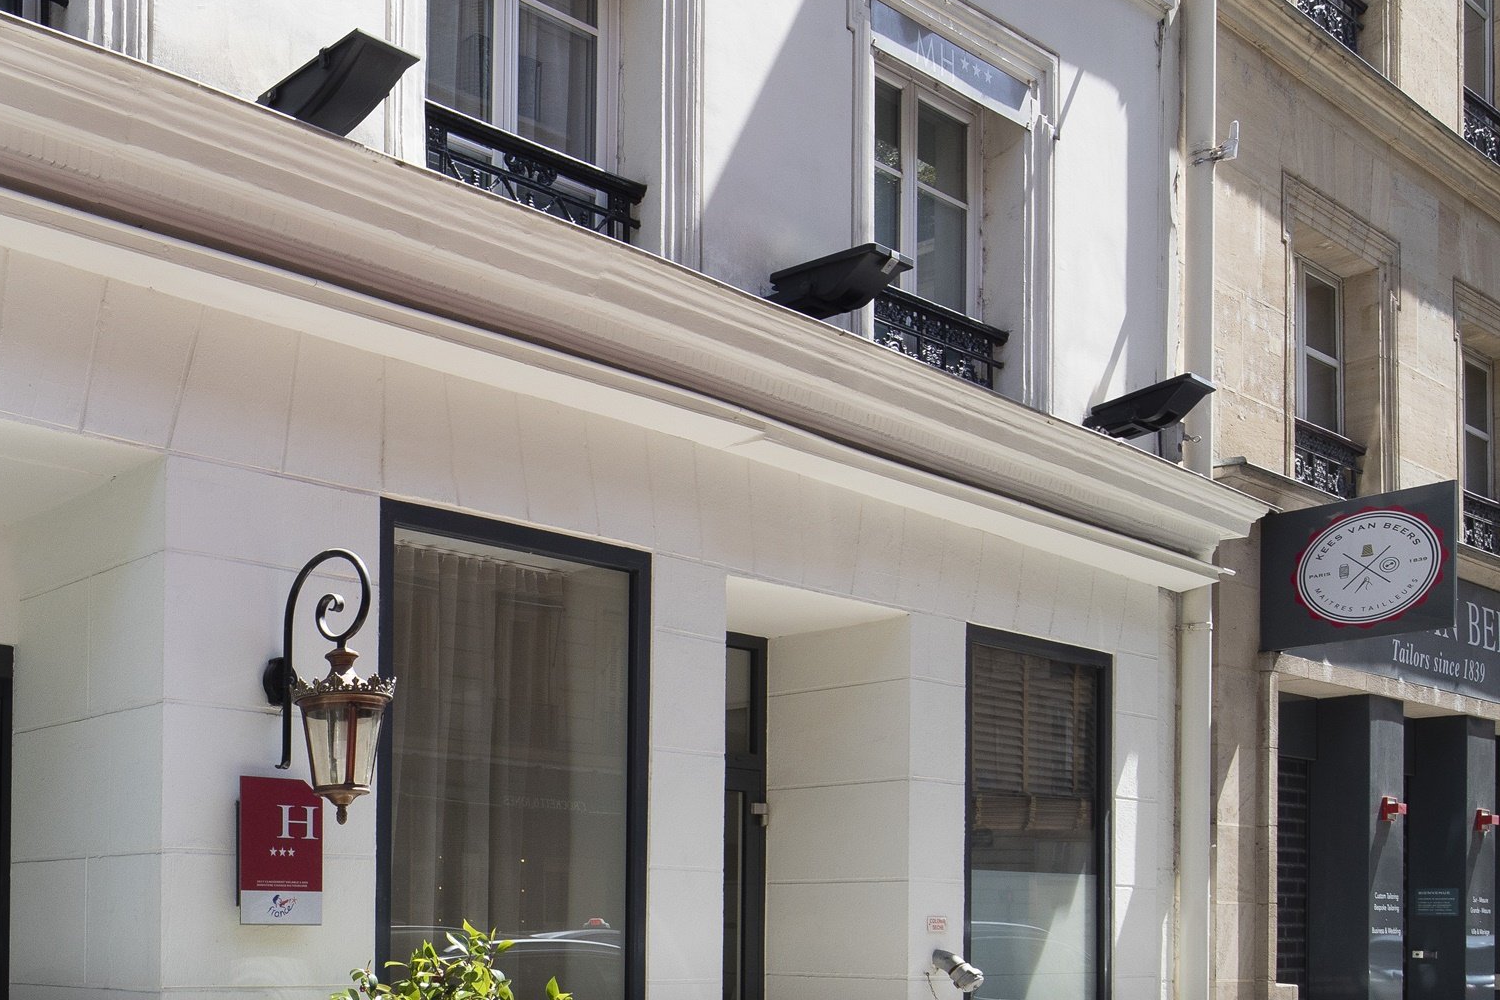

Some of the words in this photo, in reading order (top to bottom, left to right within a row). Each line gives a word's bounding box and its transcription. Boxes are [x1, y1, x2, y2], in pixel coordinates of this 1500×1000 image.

[1315, 534, 1343, 561] KEES
[1348, 522, 1376, 534] VAN
[1383, 522, 1421, 546] BEERS
[1361, 578, 1419, 612] TAILLEURS
[1466, 601, 1500, 653] BE
[1392, 639, 1430, 670] Tailors
[1434, 651, 1460, 677] since
[1463, 659, 1485, 683] 1839
[276, 804, 319, 840] H
